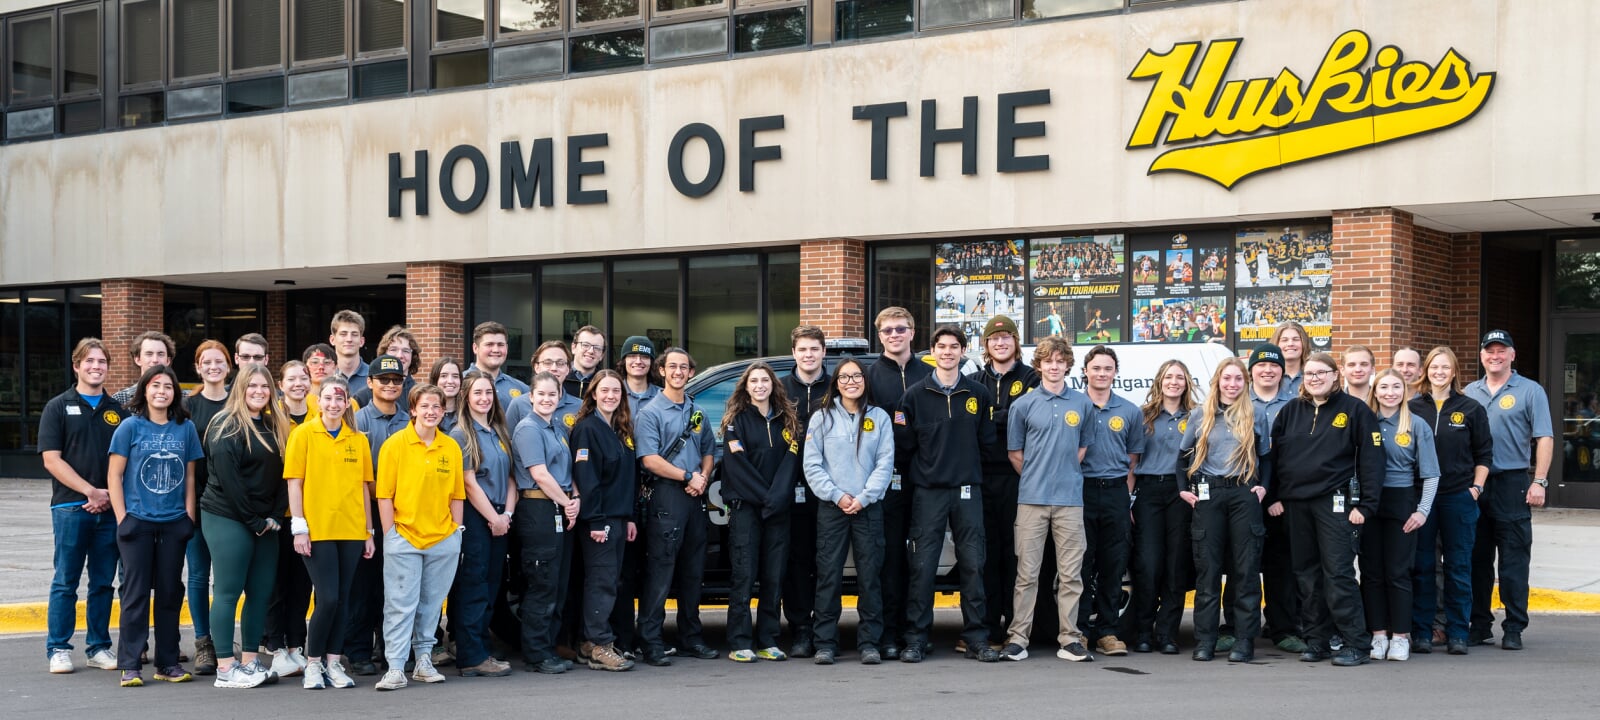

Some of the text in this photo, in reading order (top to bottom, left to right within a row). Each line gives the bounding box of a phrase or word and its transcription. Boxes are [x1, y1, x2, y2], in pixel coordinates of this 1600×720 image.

[388, 29, 1475, 218] HOME OF THE Huskies
[1048, 286, 1068, 296] NCAA
[1069, 284, 1120, 296] TOURNAMENT
[1488, 331, 1505, 340] EMS
[639, 345, 651, 354] EMS
[1265, 351, 1279, 360] EMS
